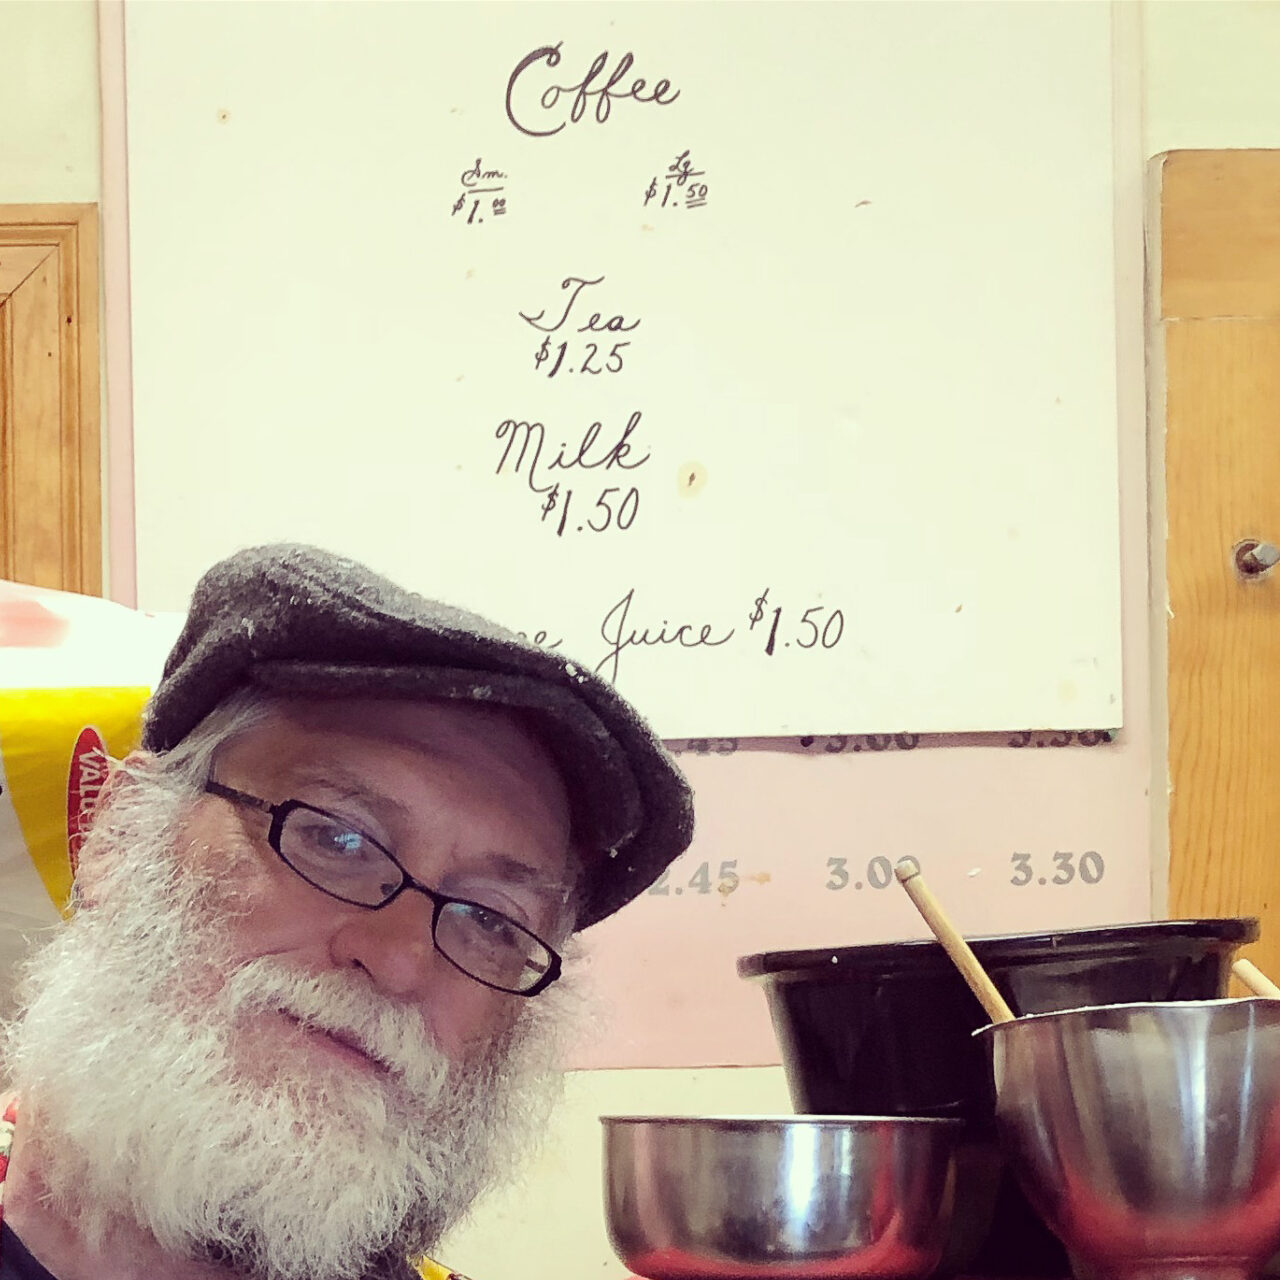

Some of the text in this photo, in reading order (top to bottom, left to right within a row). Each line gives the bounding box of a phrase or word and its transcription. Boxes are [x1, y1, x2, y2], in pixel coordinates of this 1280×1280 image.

[505, 41, 681, 137] Coffee
[644, 176, 708, 209] $1.50
[519, 276, 641, 332] Tea
[535, 335, 631, 378] $1.25
[495, 411, 651, 493] Milk
[542, 483, 640, 537] $1.50
[595, 587, 845, 685] Juice $1.50
[1010, 851, 1105, 887] 3.30
